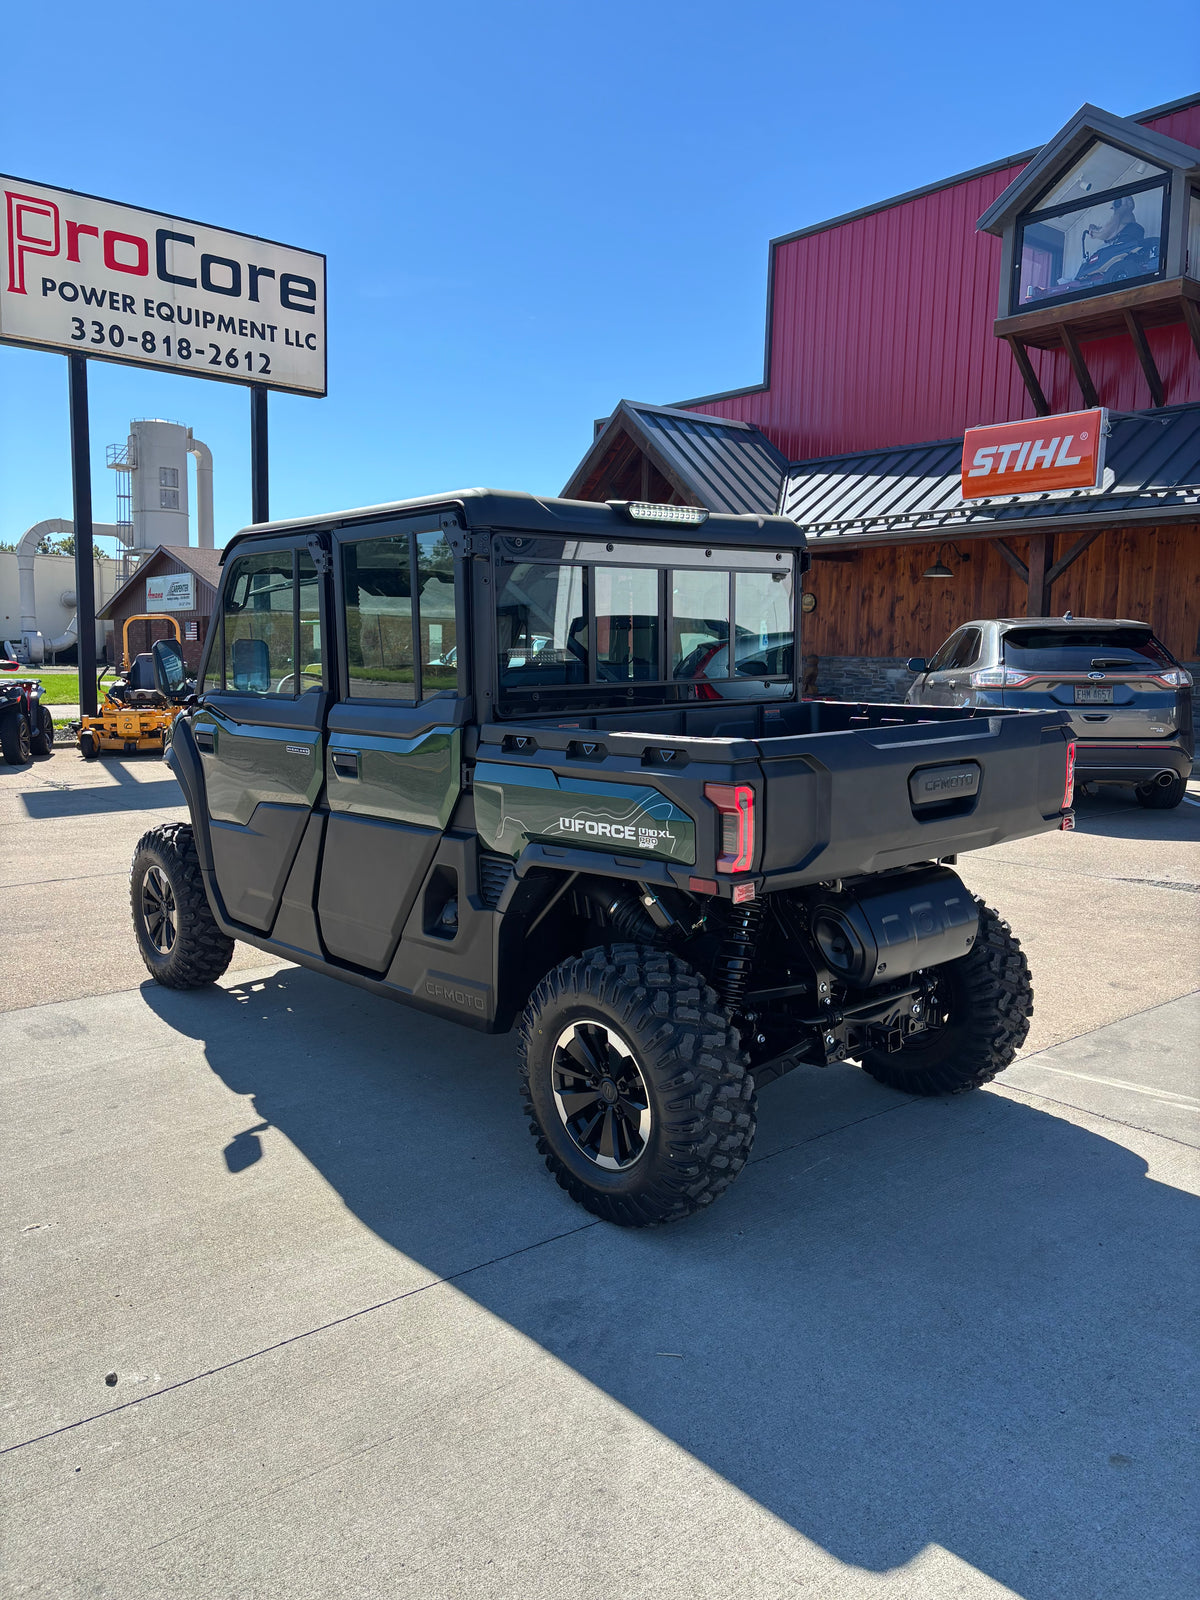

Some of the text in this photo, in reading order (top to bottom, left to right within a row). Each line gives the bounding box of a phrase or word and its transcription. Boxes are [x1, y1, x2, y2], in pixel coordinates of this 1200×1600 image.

[4, 190, 317, 315] ProCore
[41, 276, 317, 351] POWER EQUIPMENT LLC
[70, 316, 272, 375] 330-818-2612
[967, 434, 1082, 478] STIHL
[925, 773, 974, 791] CFMOTO
[559, 817, 637, 840] UFORCE
[425, 981, 484, 1010] CFMOTO
